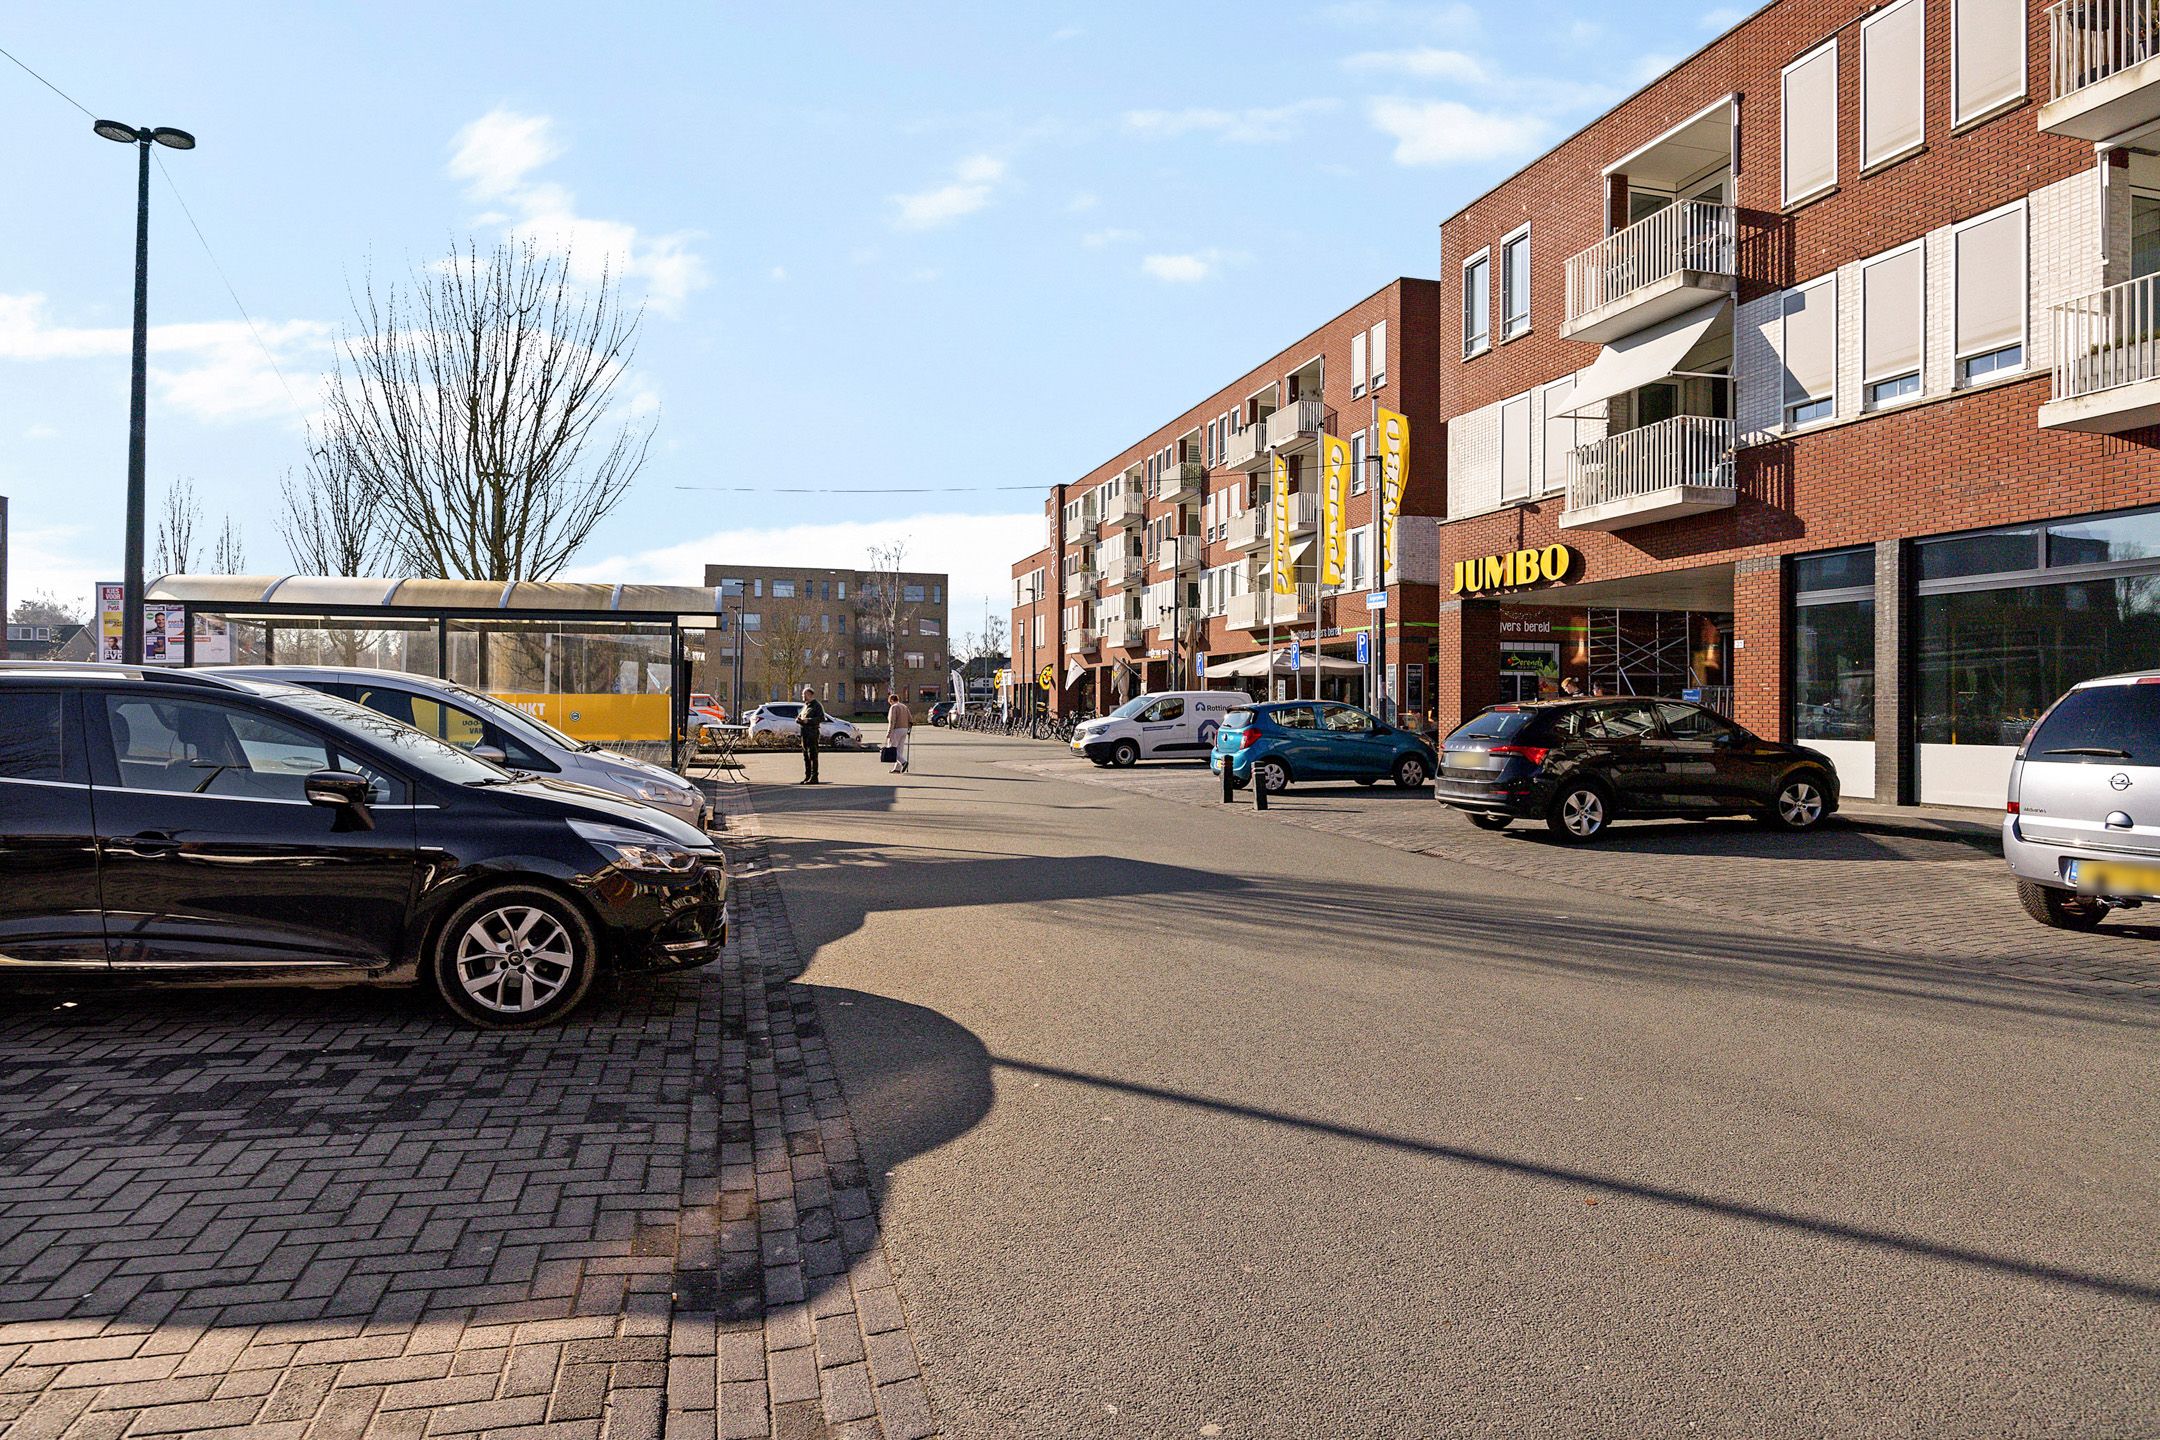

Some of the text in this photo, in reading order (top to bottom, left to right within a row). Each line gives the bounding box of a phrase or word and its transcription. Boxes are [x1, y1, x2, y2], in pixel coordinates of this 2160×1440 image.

[1450, 543, 1570, 595] JUMBO
[1524, 621, 1550, 633] bereid
[1359, 635, 1366, 650] P
